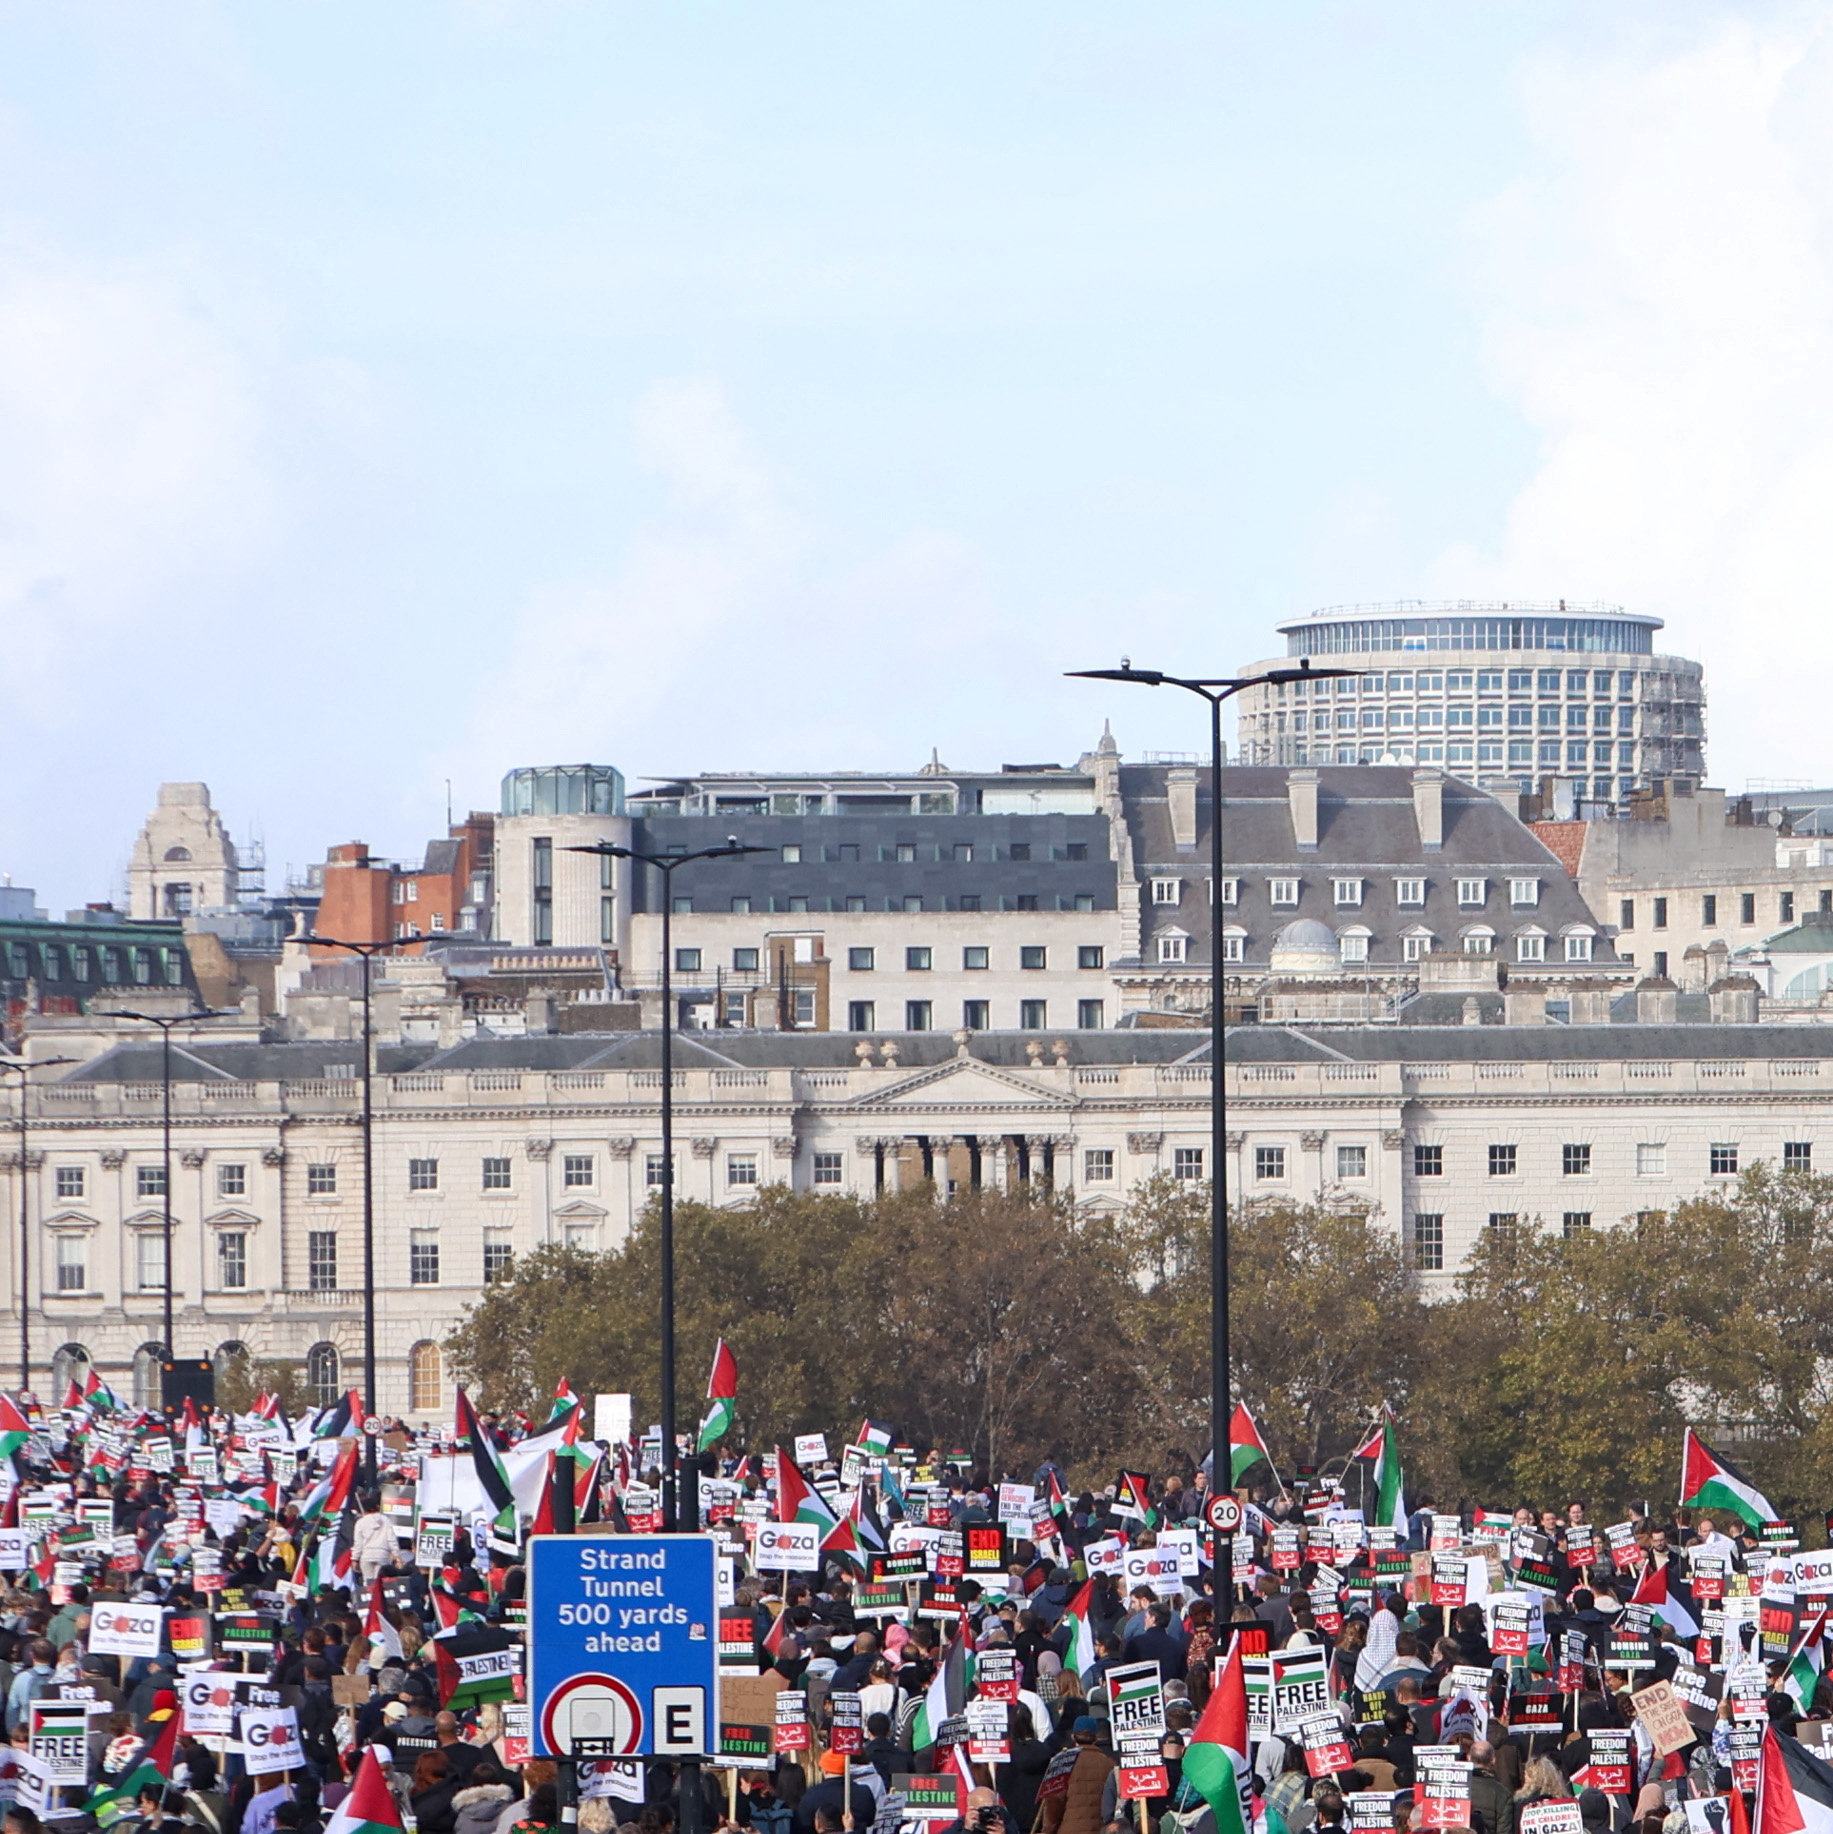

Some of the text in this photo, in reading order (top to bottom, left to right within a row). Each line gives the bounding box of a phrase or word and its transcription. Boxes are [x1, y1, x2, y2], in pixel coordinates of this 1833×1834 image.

[364, 1418, 380, 1433] 20
[1212, 1505, 1237, 1522] 20
[758, 1529, 815, 1550] Gza
[968, 1529, 1000, 1549] END
[580, 1548, 667, 1572] Strand
[970, 1549, 1000, 1560] ISRAELI
[581, 1575, 664, 1600] Tunnel
[558, 1603, 689, 1632] 500 yards
[224, 1628, 273, 1639] PALESTINE
[585, 1631, 662, 1654] ahead
[249, 1689, 281, 1703] Free
[665, 1704, 693, 1744] E
